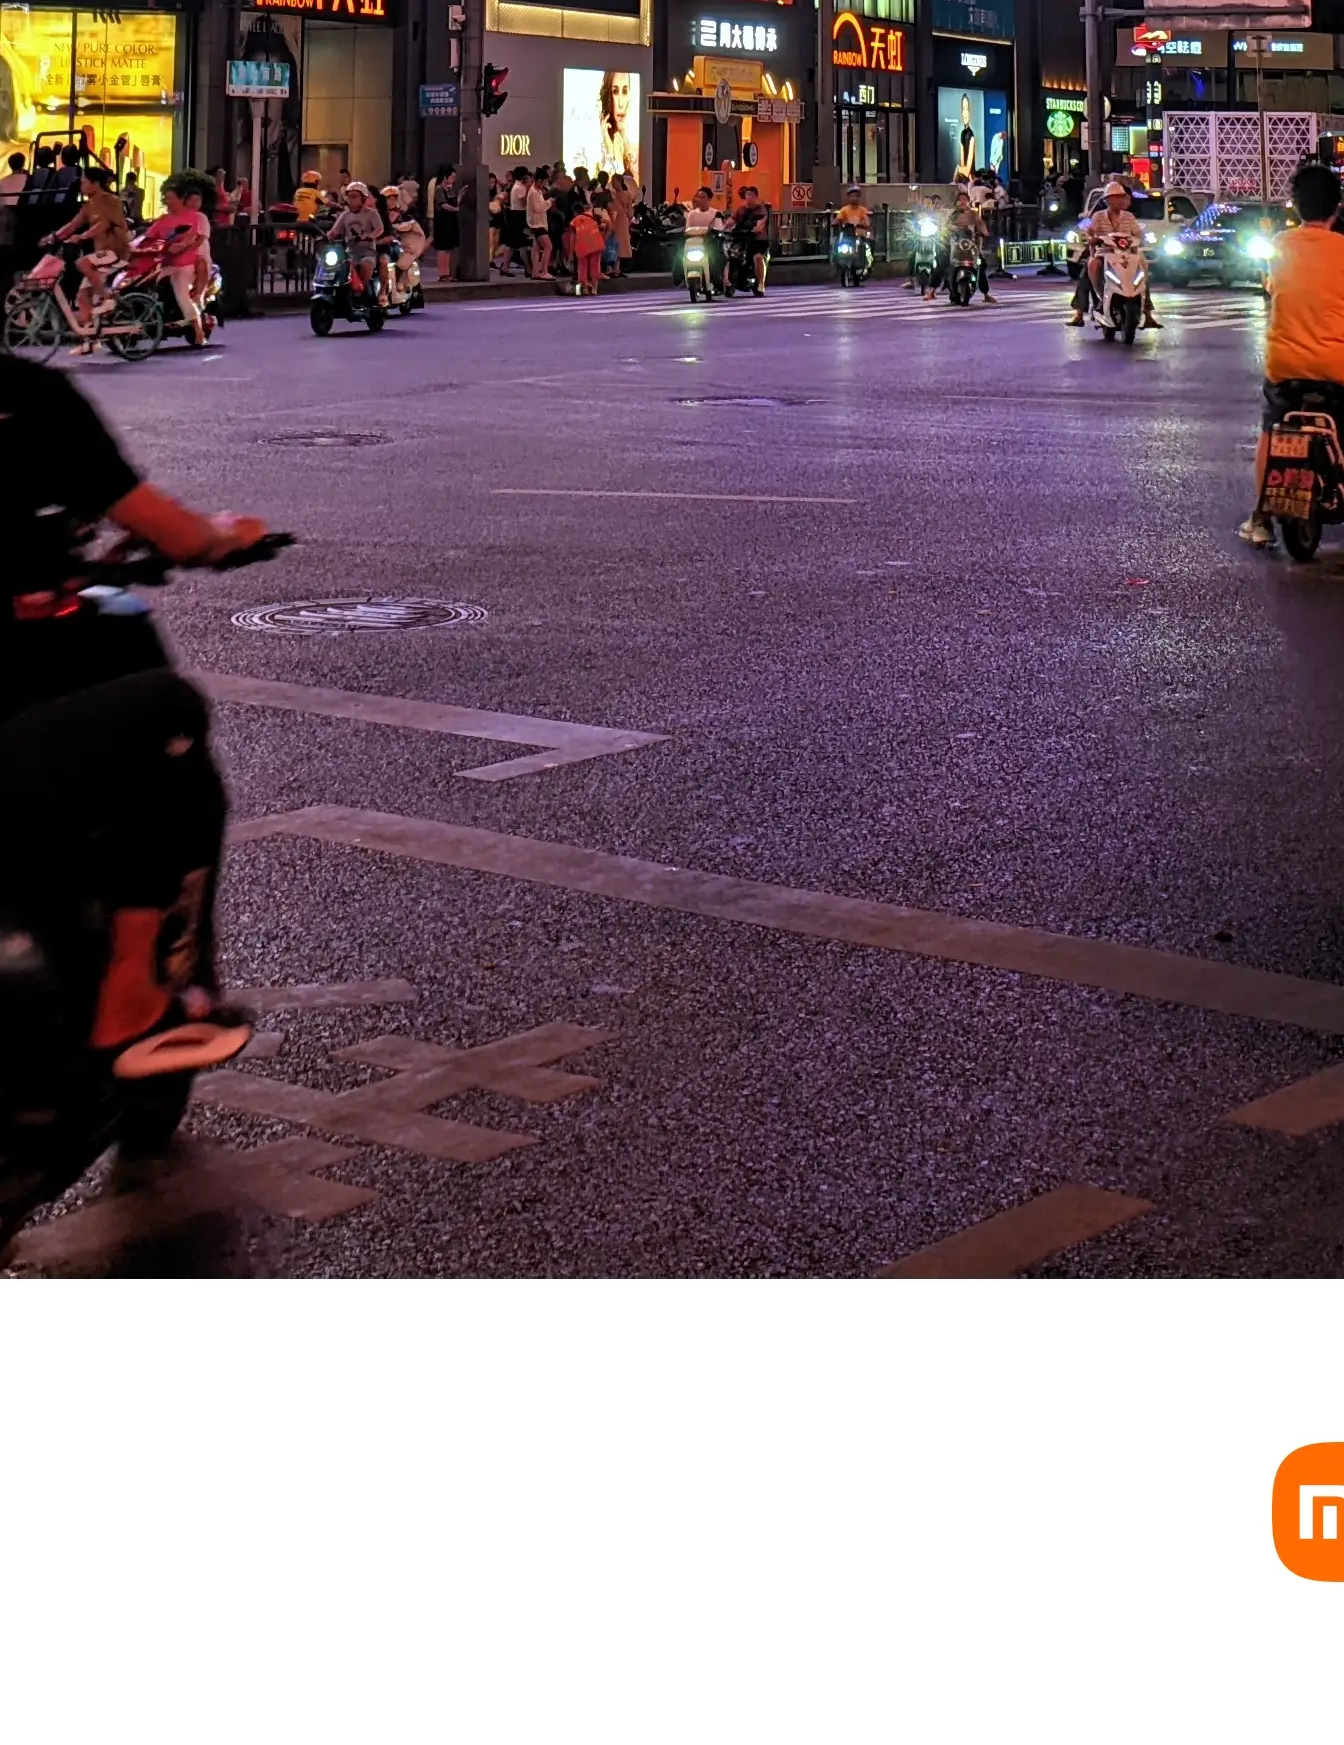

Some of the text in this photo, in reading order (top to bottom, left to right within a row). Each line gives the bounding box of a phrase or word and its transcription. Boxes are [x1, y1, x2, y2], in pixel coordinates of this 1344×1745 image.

[83, 42, 113, 54] PURE
[115, 43, 157, 55] COLOR
[870, 26, 903, 71] 天虹
[60, 57, 147, 69] LISTICK MATTE
[833, 49, 863, 67] RAINBOW
[500, 134, 531, 157] DIOR
